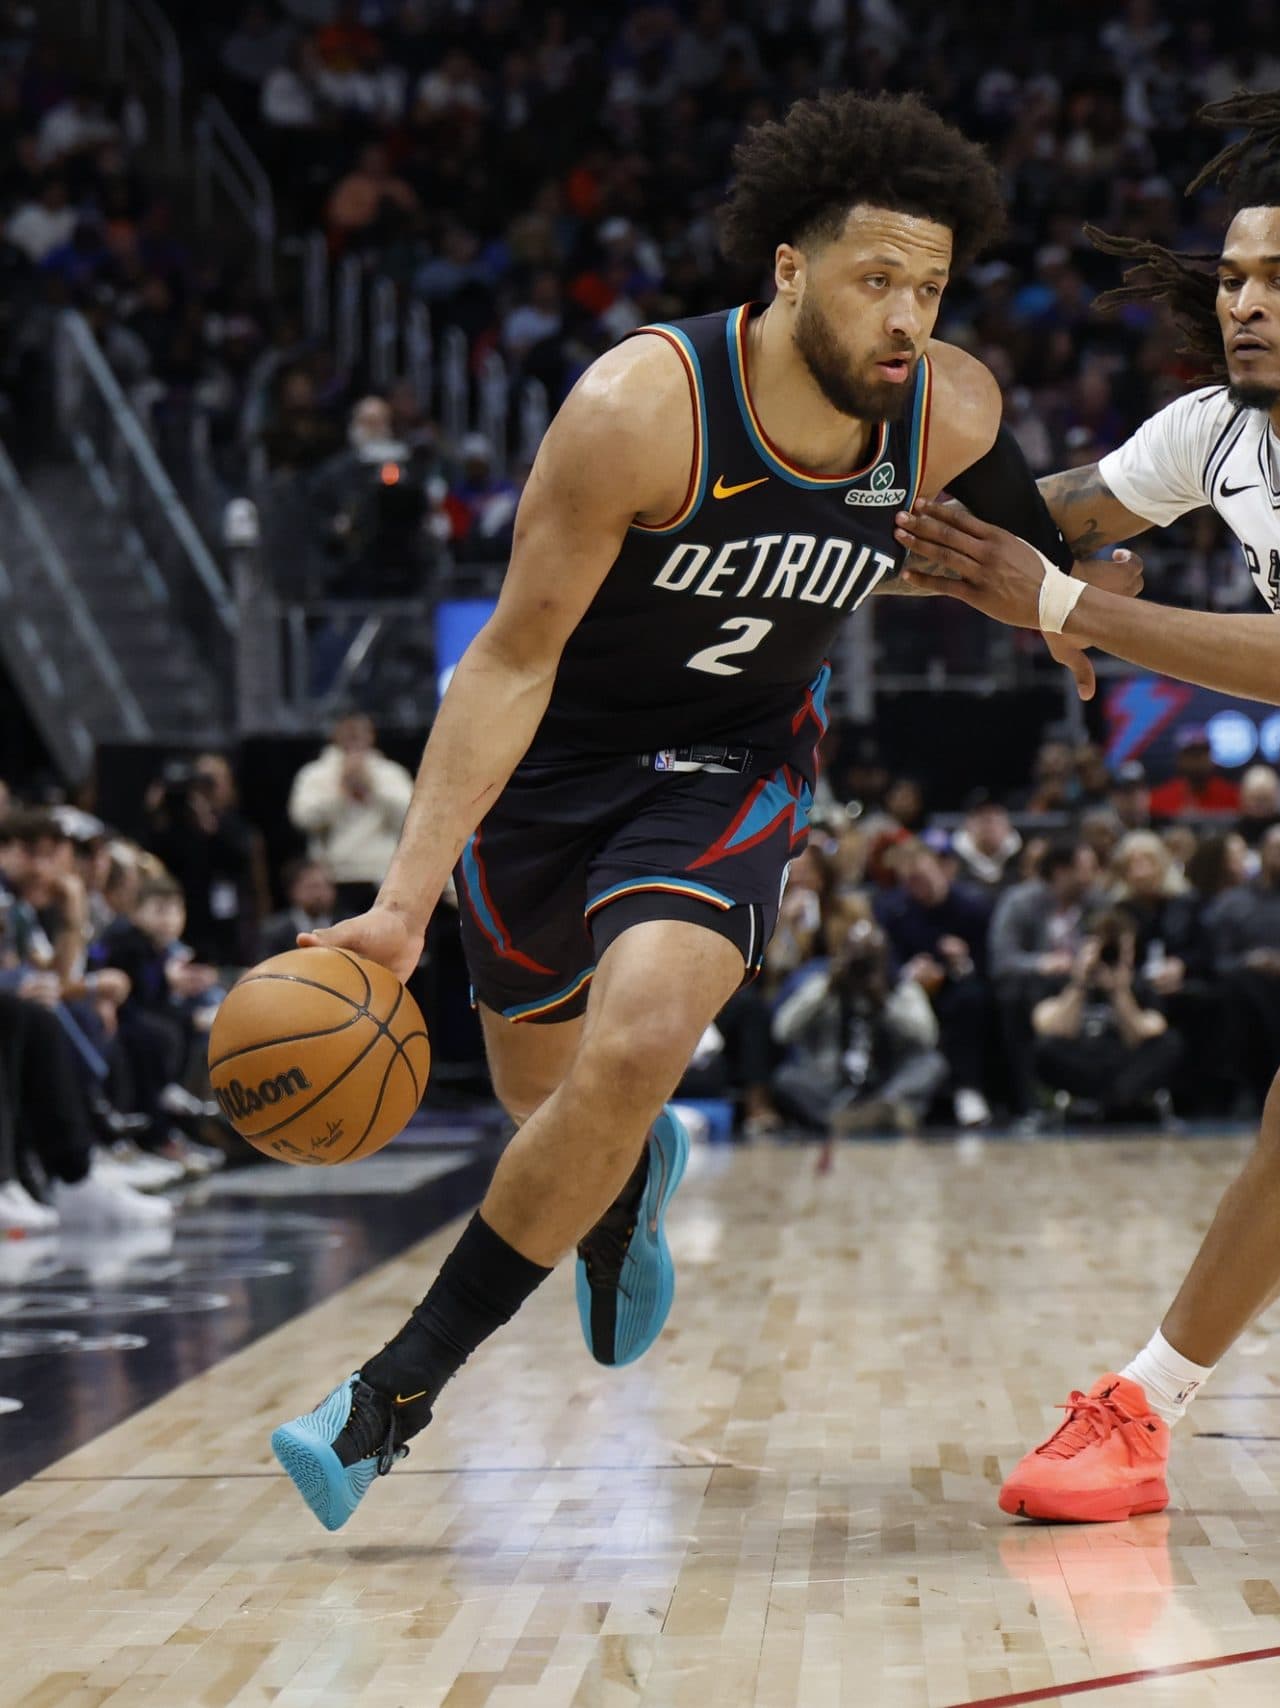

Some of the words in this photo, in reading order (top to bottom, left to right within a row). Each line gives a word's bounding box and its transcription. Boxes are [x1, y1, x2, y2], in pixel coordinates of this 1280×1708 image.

[847, 490, 905, 504] StockX
[652, 533, 896, 612] DETROIT
[685, 616, 773, 677] 2
